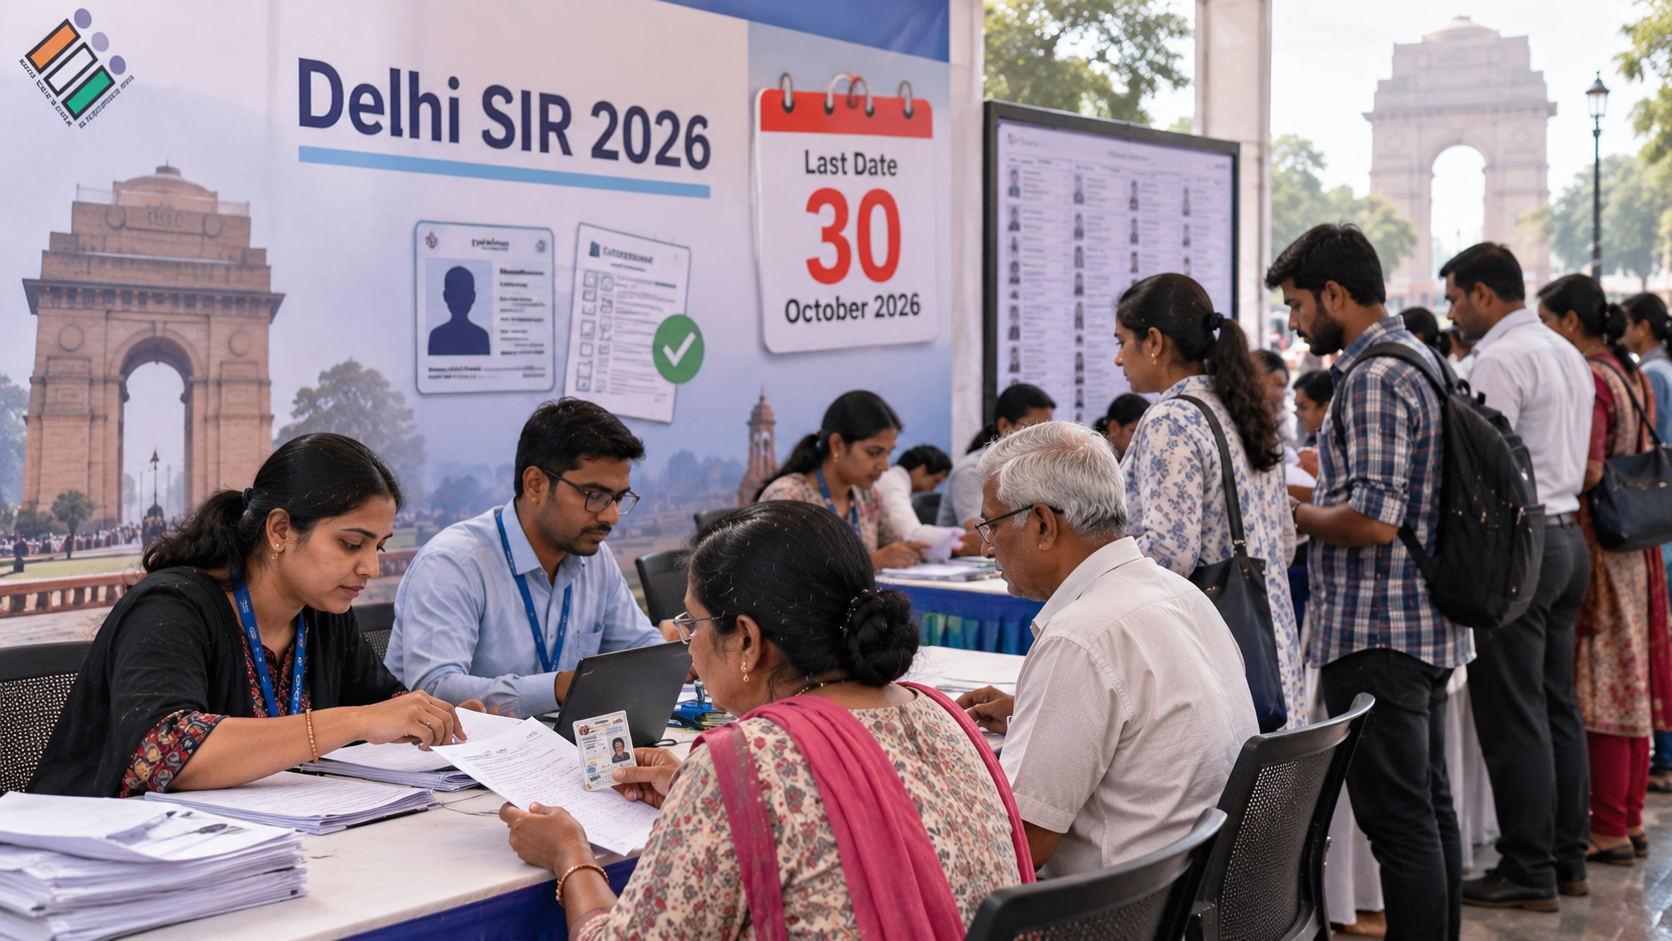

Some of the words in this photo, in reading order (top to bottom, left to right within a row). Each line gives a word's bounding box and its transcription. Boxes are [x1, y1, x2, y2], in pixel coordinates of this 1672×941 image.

[298, 57, 460, 144] Delhi
[481, 84, 574, 157] SIR
[590, 100, 712, 171] 2026
[804, 149, 847, 176] Last
[853, 151, 898, 177] Date
[805, 187, 901, 285] 30
[784, 295, 869, 325] October
[873, 292, 921, 319] 2026
